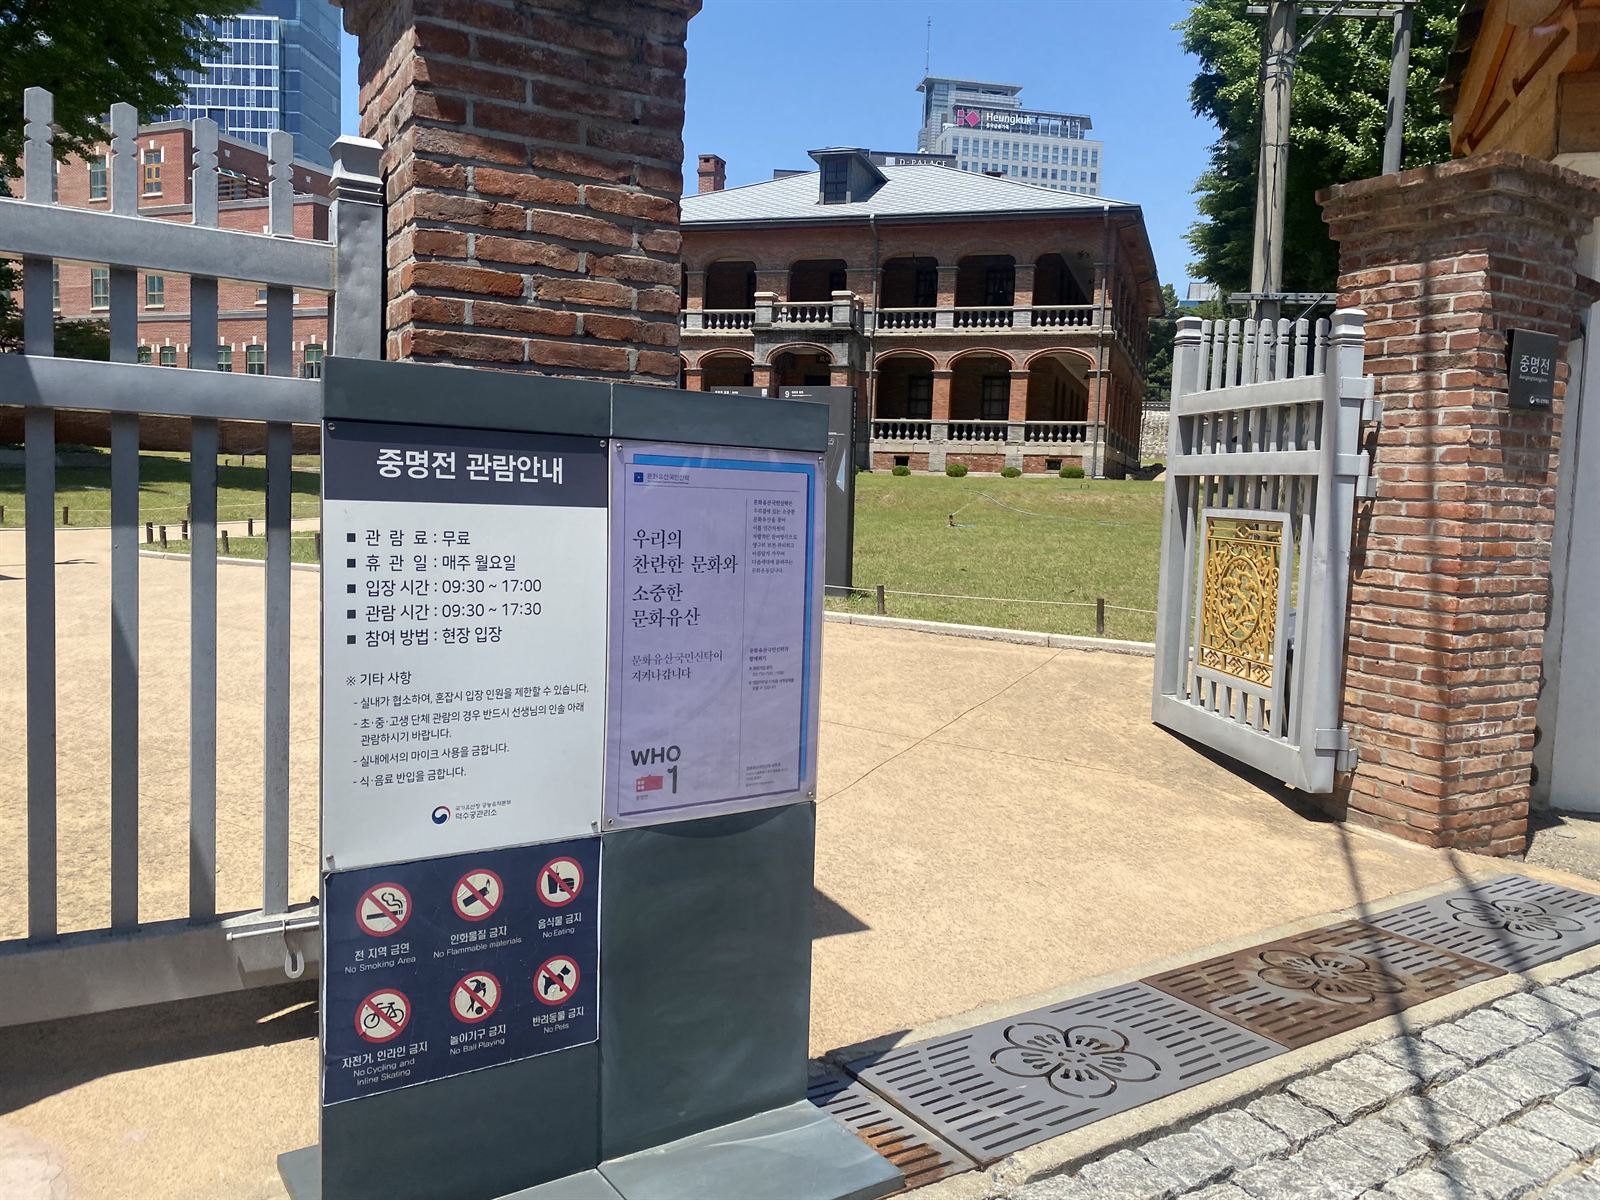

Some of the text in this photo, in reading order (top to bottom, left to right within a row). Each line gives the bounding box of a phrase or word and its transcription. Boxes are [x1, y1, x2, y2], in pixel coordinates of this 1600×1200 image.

[986, 112, 1032, 126] Heungkuk
[1520, 354, 1550, 375] 중명전
[784, 390, 790, 398] 9
[376, 448, 564, 485] 중명전 관람안내
[442, 530, 470, 547] 무료
[632, 528, 682, 550] 우리의
[442, 554, 470, 572] 매주
[475, 555, 516, 572] 월요일
[632, 554, 738, 574] 찬란한 문화와
[366, 580, 396, 597] 입장
[400, 580, 430, 596] 시간
[442, 580, 484, 593] 09:30
[502, 579, 542, 592] 17:00
[632, 583, 683, 602] 소중한
[366, 604, 396, 622] 관람
[400, 604, 430, 620] 시간
[442, 604, 484, 618] 09:30
[502, 602, 542, 616] 17:30
[632, 607, 700, 628] 문화유산
[366, 630, 395, 648] 참여
[400, 628, 428, 646] 방법
[442, 626, 470, 644] 현장
[475, 626, 502, 642] 입장
[632, 650, 723, 667] 문화유산국민신탁이
[360, 671, 412, 686] 기타 사항
[360, 683, 589, 710] 실내가 협소하여, 혼잡시 입장 인원을 제한할 수 있습니다.
[360, 702, 584, 729] 초·중·고생 단체 관람의 경우 반드시 선생님의 인솔 아래
[412, 728, 452, 742] 바랍니다.
[360, 742, 510, 768] 실내에서의 마이크 사용을 금합니다.
[631, 746, 681, 766] WHO
[360, 766, 466, 787] 식·음료 반입을 금합니다.
[668, 765, 678, 794] 1
[456, 809, 496, 820] 덕수궁관리소
[538, 912, 582, 930] 음식물 금지
[450, 926, 507, 945] 인화물질 금지
[554, 926, 575, 937] Eating
[354, 942, 410, 962] 전 지역 금연
[433, 938, 522, 958] No Flammable materials
[344, 956, 416, 974] No Smoking Area
[532, 1006, 584, 1027] 반려동물 금지
[450, 1024, 506, 1046] 놀이기구 금지
[544, 1022, 570, 1034] No Pets
[376, 1046, 406, 1061] 인라인
[409, 1041, 428, 1053] 금지
[450, 1038, 506, 1056] No Ball Playing
[354, 1058, 415, 1078] No Cycling and
[356, 1068, 411, 1086] Inline Skating
